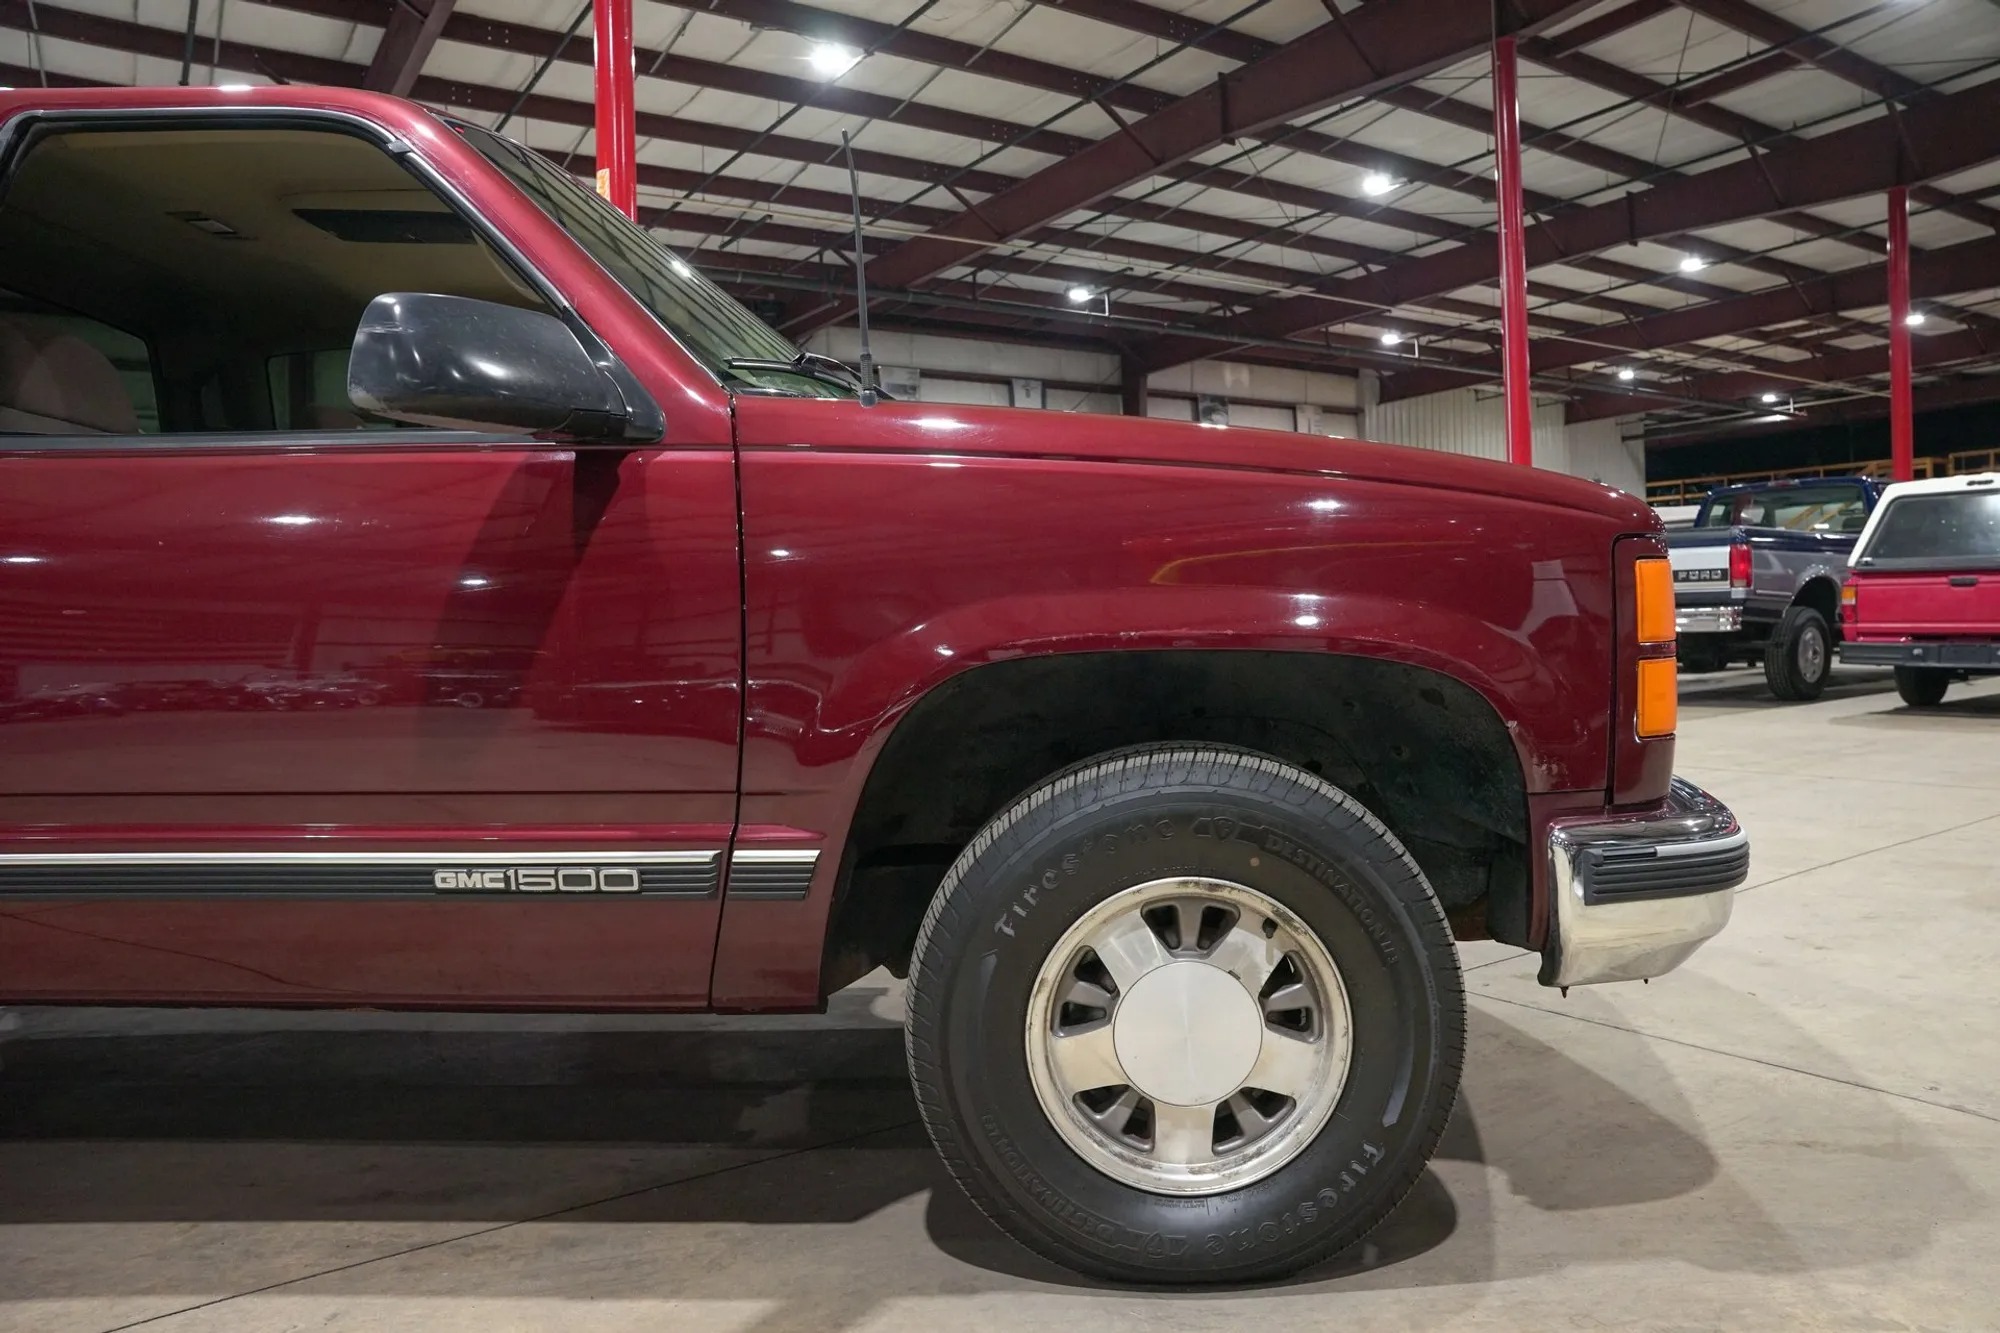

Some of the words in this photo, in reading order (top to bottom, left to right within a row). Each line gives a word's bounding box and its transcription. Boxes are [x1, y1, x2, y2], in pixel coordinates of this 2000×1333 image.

[1678, 569, 1722, 581] FORD
[434, 871, 504, 889] GMC
[505, 868, 640, 892] 1500
[993, 818, 1175, 937] Firestone
[1263, 834, 1386, 940] DESTINATION
[1205, 1139, 1386, 1257] Firestone
